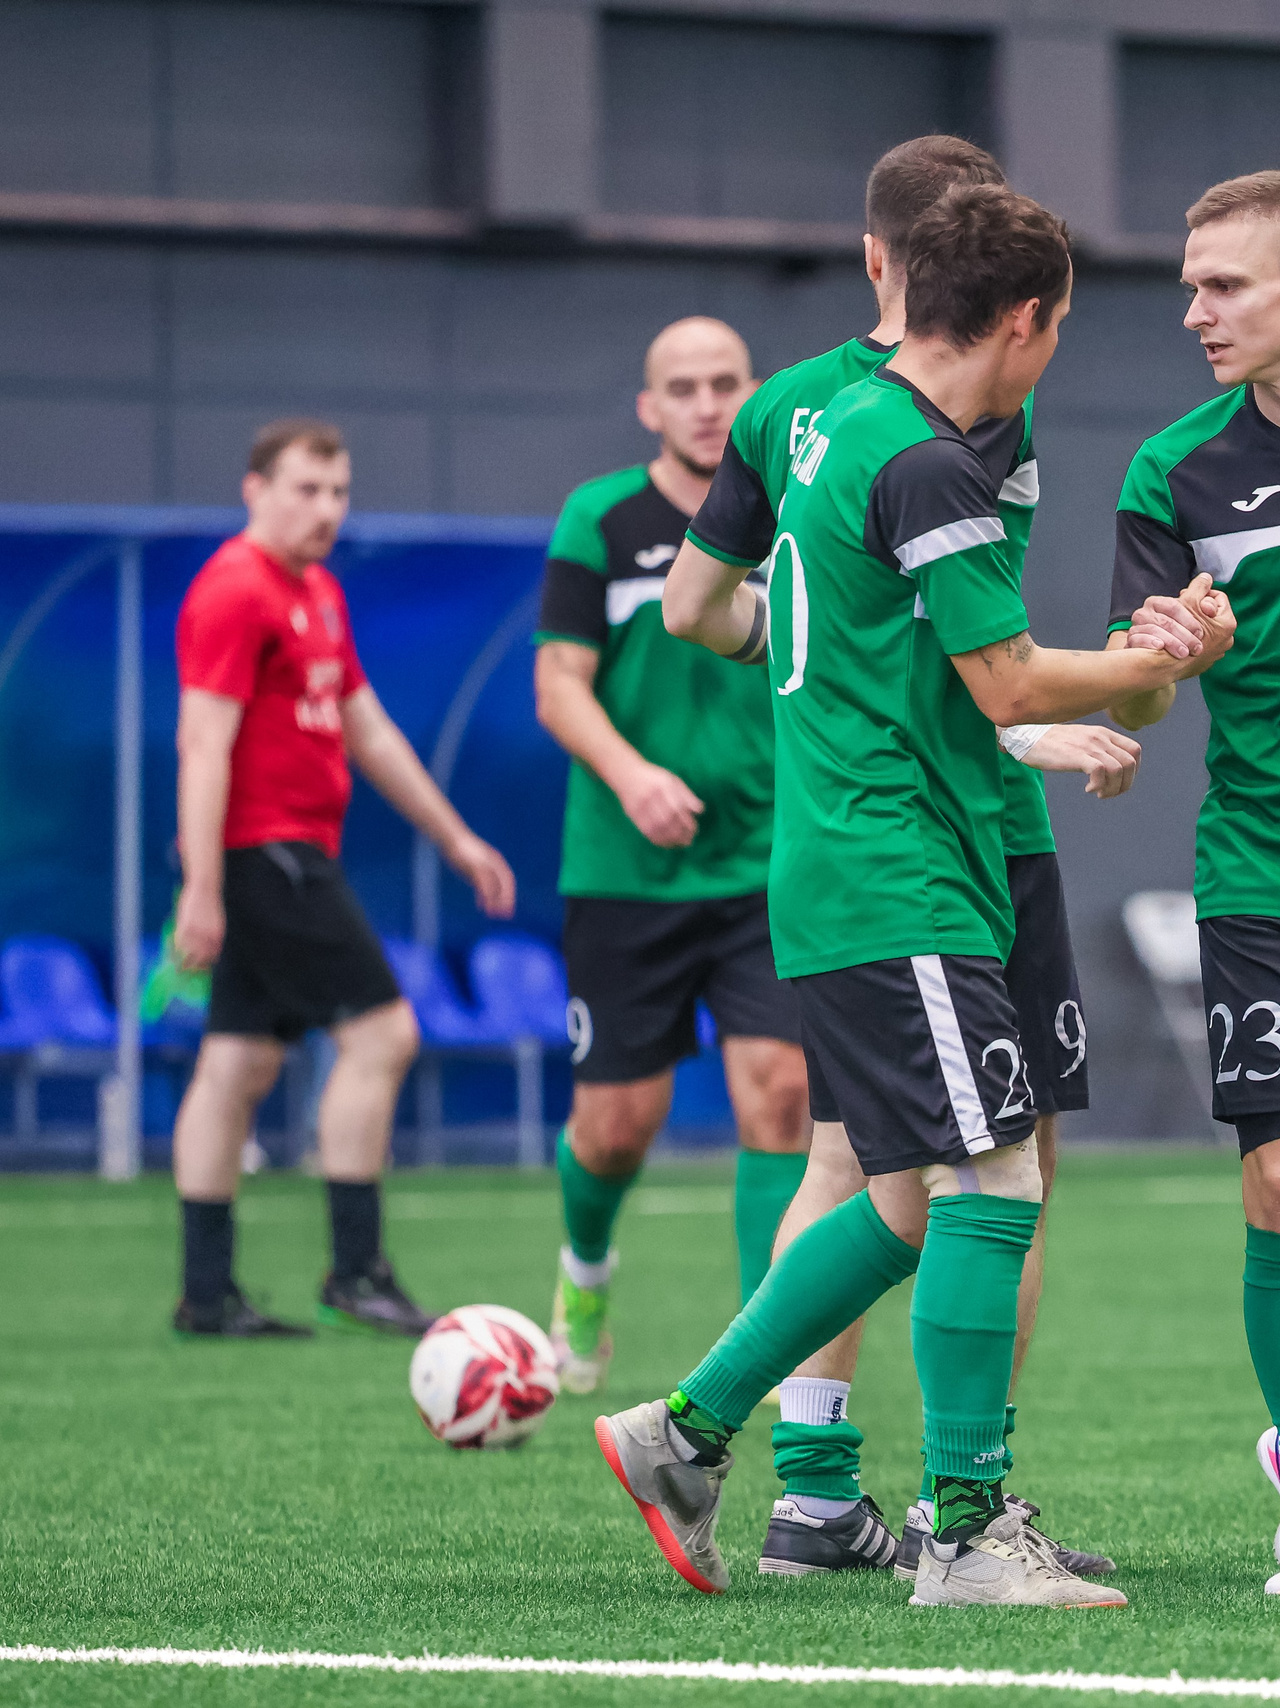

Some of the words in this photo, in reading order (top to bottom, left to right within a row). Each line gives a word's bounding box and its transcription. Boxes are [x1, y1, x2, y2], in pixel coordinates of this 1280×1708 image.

[566, 996, 593, 1066] 9
[1055, 999, 1087, 1079] 9
[981, 1033, 1035, 1119] 2
